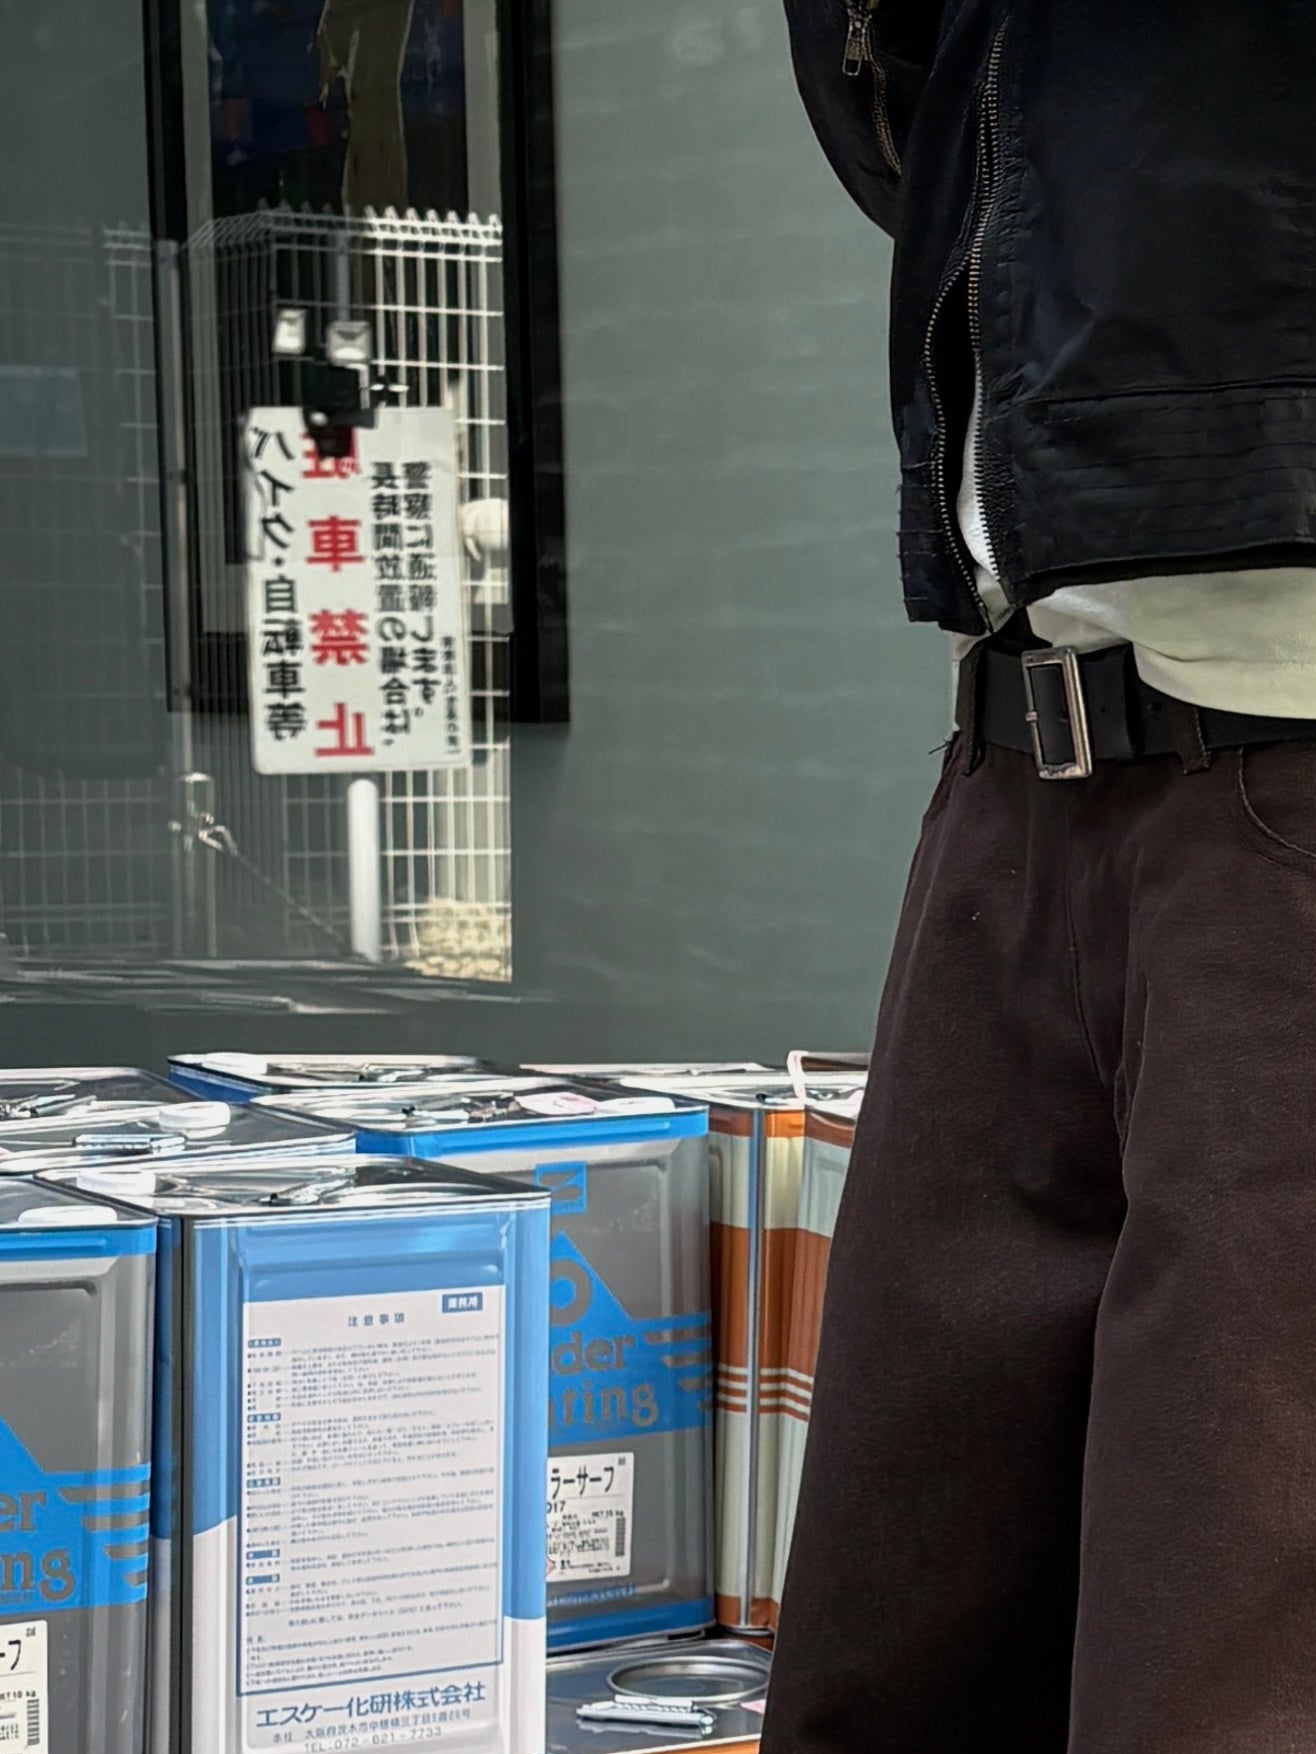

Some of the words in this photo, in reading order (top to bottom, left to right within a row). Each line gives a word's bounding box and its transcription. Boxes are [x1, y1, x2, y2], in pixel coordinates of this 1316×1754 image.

[256, 1680, 486, 1728] エスケー化研株式会社
